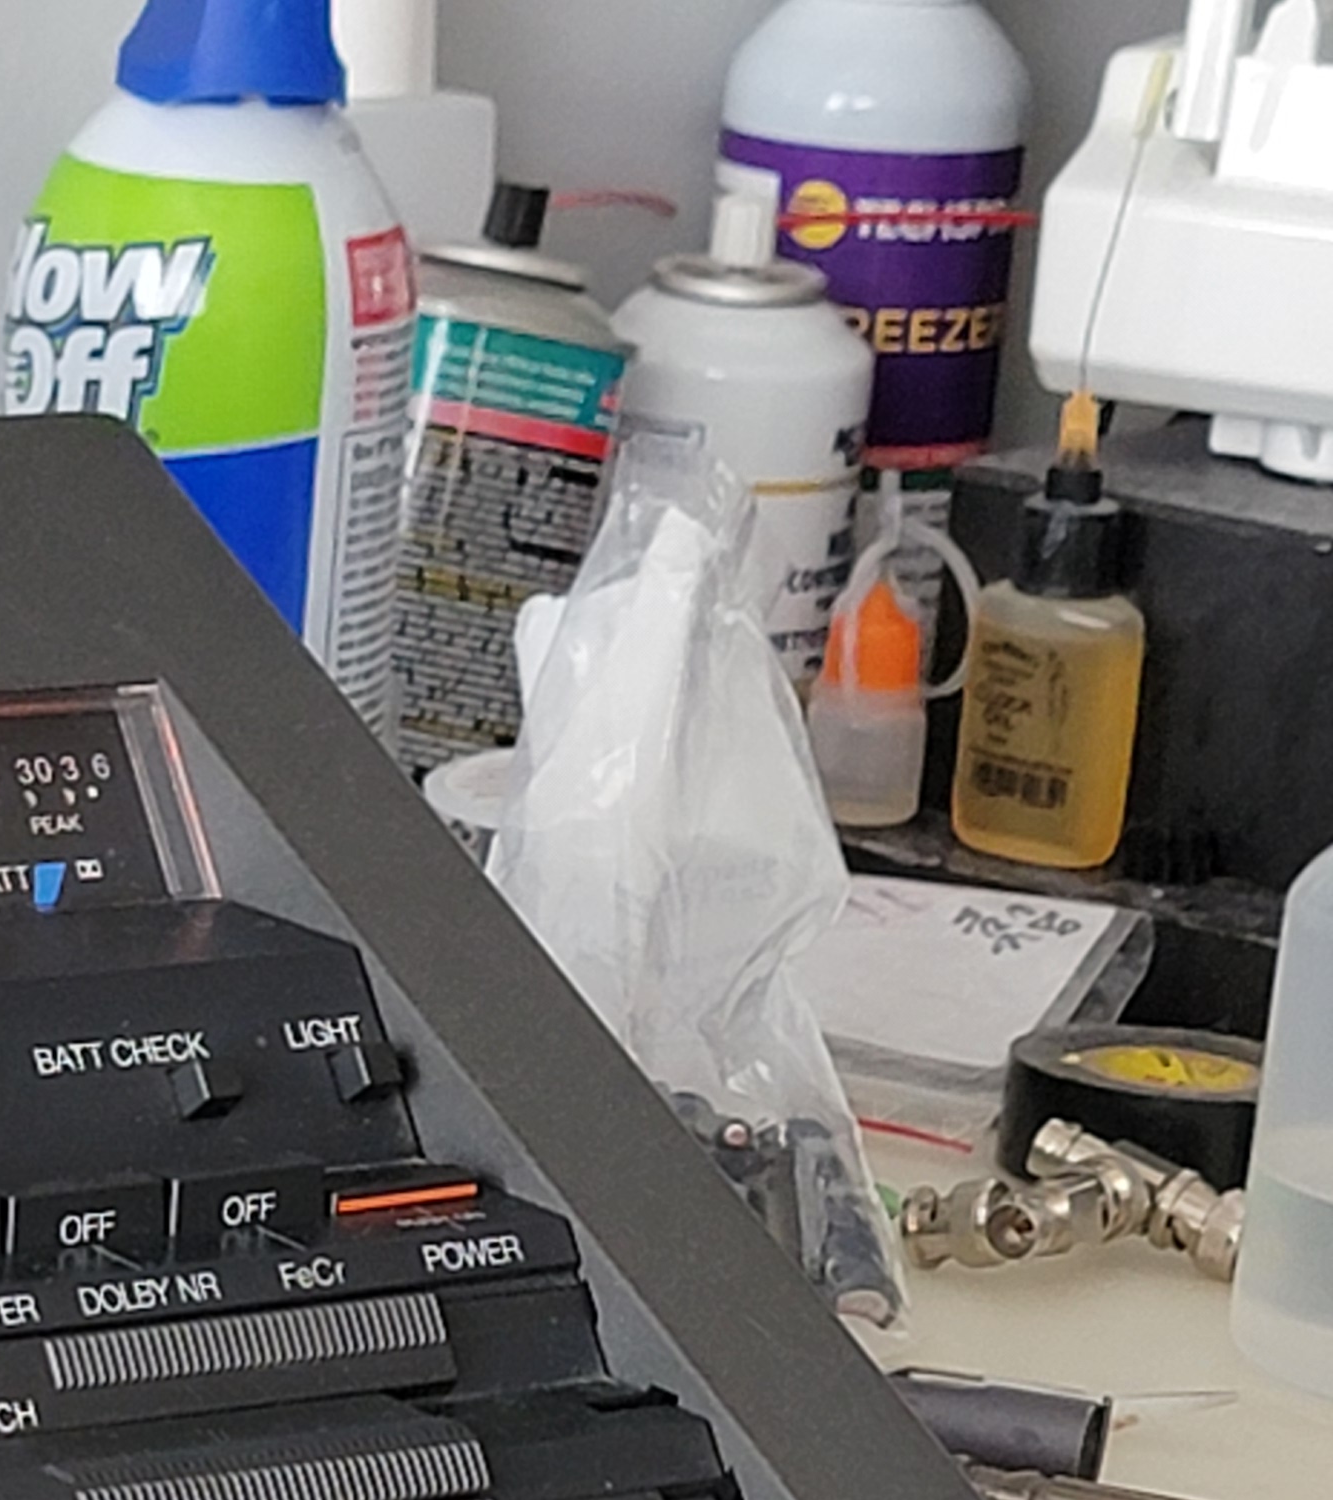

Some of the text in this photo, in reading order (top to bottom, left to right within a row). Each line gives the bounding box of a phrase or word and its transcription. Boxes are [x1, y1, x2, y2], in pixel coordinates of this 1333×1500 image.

[29, 813, 83, 835] PEAK
[33, 1031, 210, 1075] BATT CHECK
[283, 1015, 361, 1053] LIGHT
[59, 1210, 116, 1245] OFF
[222, 1191, 277, 1226] OFF
[421, 1235, 524, 1273] POWER
[278, 1257, 345, 1291] FeCr
[77, 1271, 222, 1317] DOLBY NR
